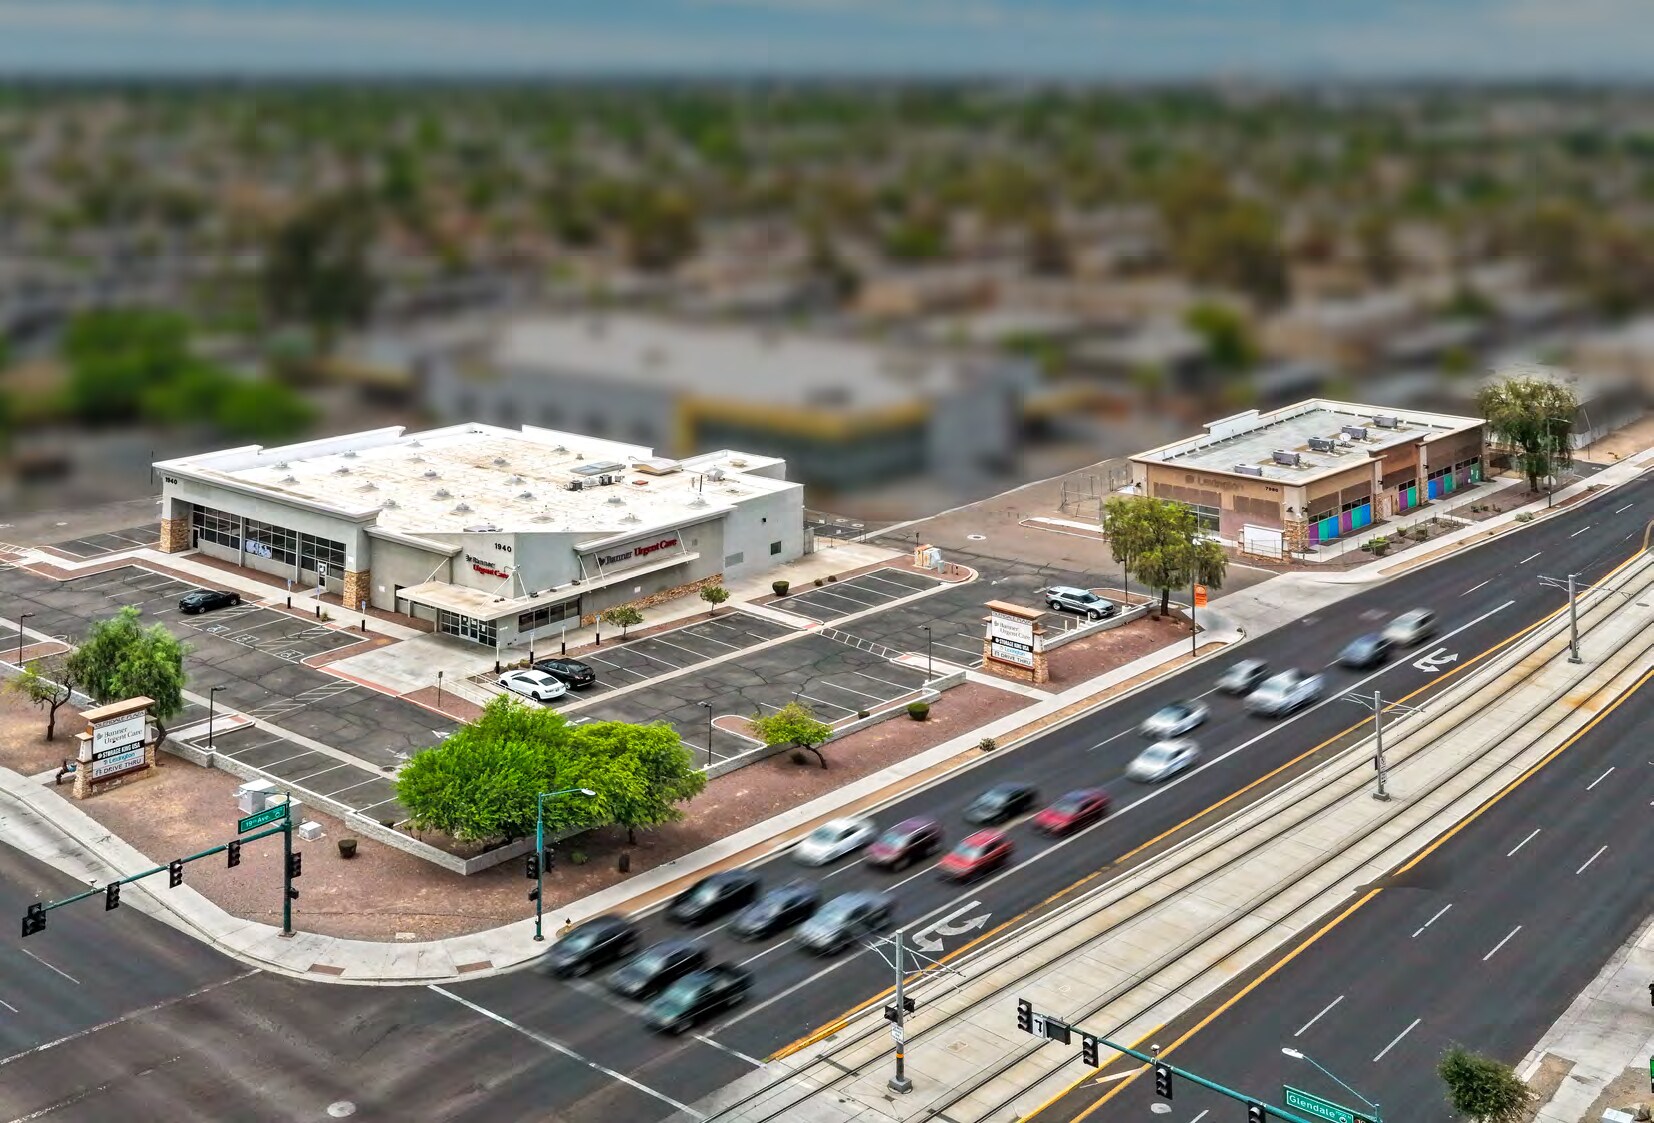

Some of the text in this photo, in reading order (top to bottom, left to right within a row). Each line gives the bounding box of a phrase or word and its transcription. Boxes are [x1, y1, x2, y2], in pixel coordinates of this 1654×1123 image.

[165, 476, 178, 485] 1940
[494, 542, 512, 553] 1940
[604, 539, 677, 565] Banner Urgent Care
[472, 556, 495, 568] Banner
[473, 563, 509, 579] Urgent Care
[1000, 622, 1019, 631] Banner
[1000, 628, 1018, 638] Urgent
[1004, 646, 1025, 657] Lexington
[1000, 652, 1031, 665] DRIVE THRU
[104, 728, 127, 738] Banner
[104, 729, 142, 744] Urgent Care
[103, 742, 141, 758] STORAGE KING USA
[108, 753, 135, 764] Lexington
[103, 758, 142, 774] DRIVE THRU
[1289, 1094, 1336, 1118] Glendale
